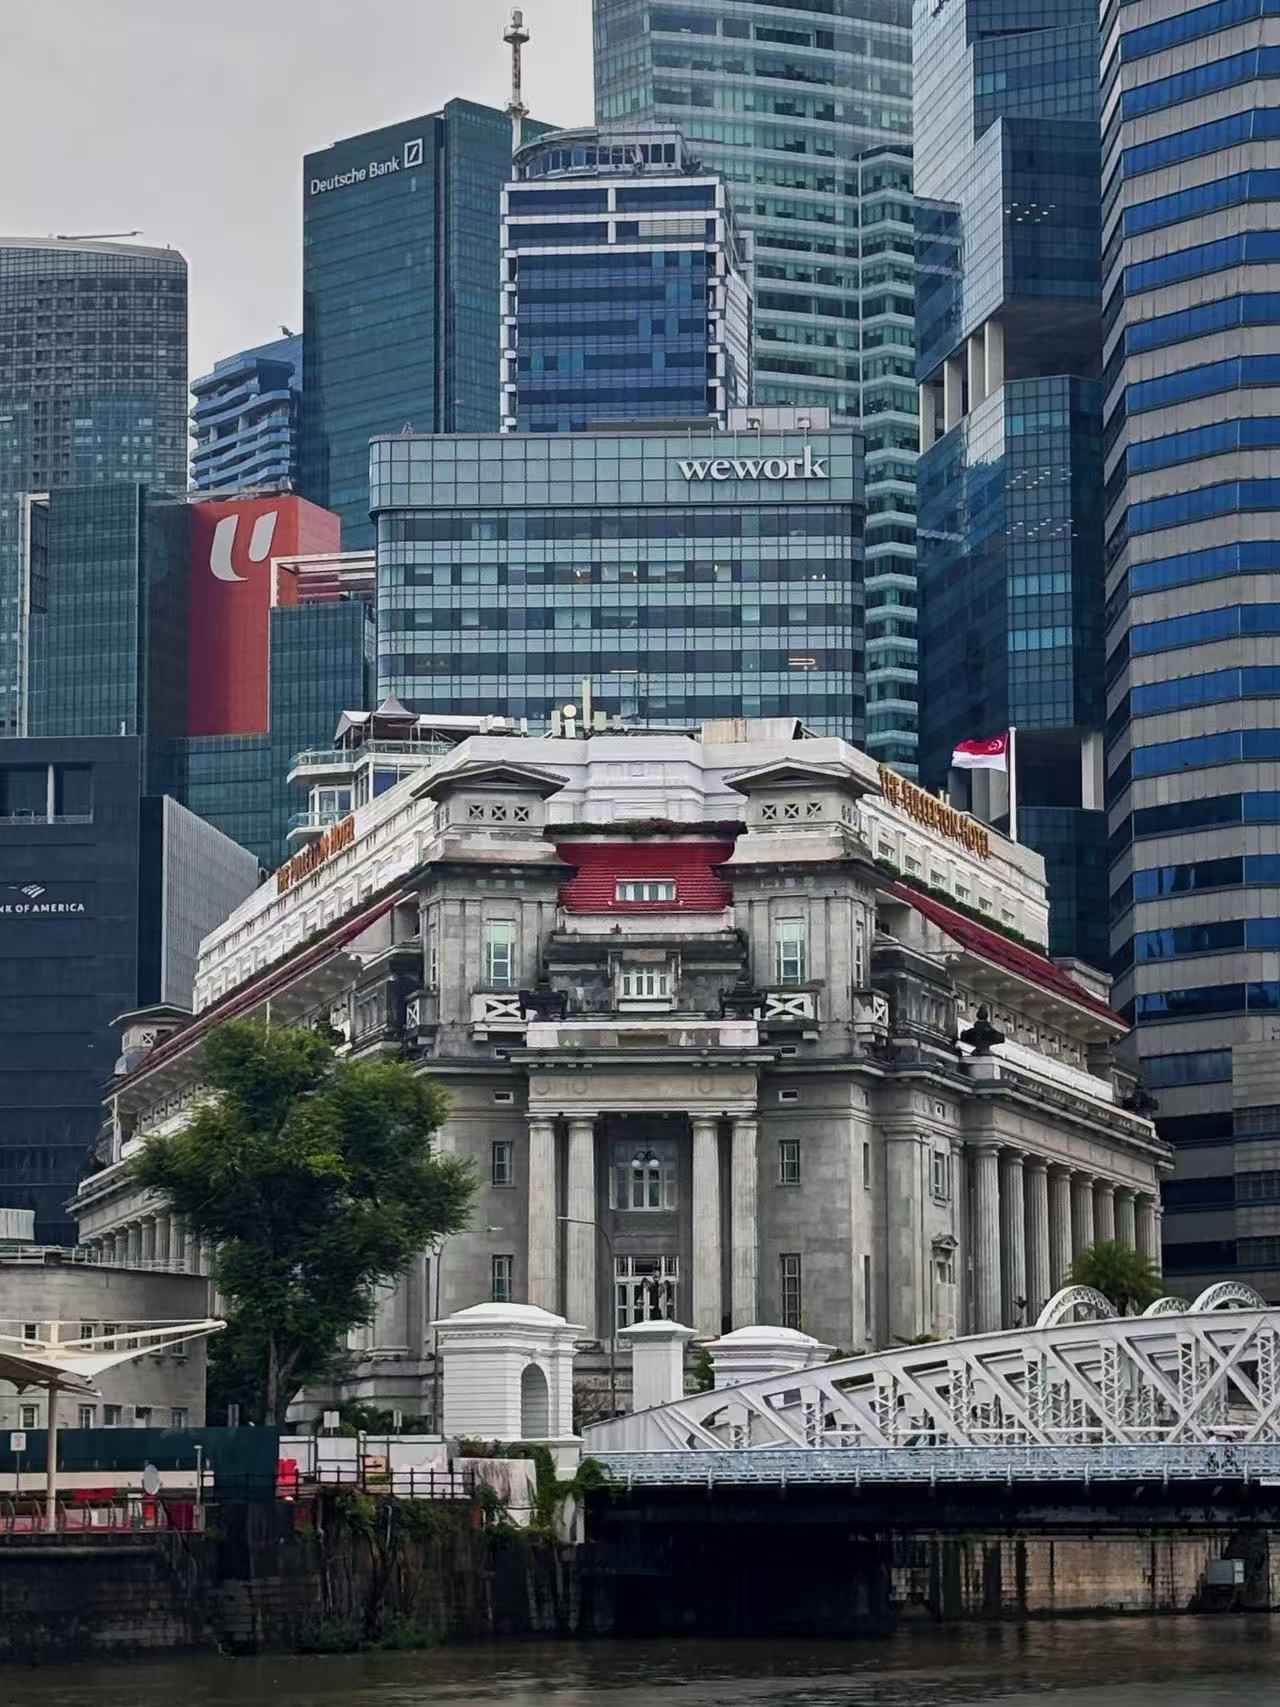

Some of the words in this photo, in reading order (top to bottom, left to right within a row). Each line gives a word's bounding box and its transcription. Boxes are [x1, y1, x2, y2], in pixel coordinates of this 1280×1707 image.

[310, 167, 366, 195] Deutsche
[369, 156, 400, 178] Bank
[676, 445, 830, 481] wework
[15, 904, 30, 913] OF
[32, 903, 85, 913] AMERICA
